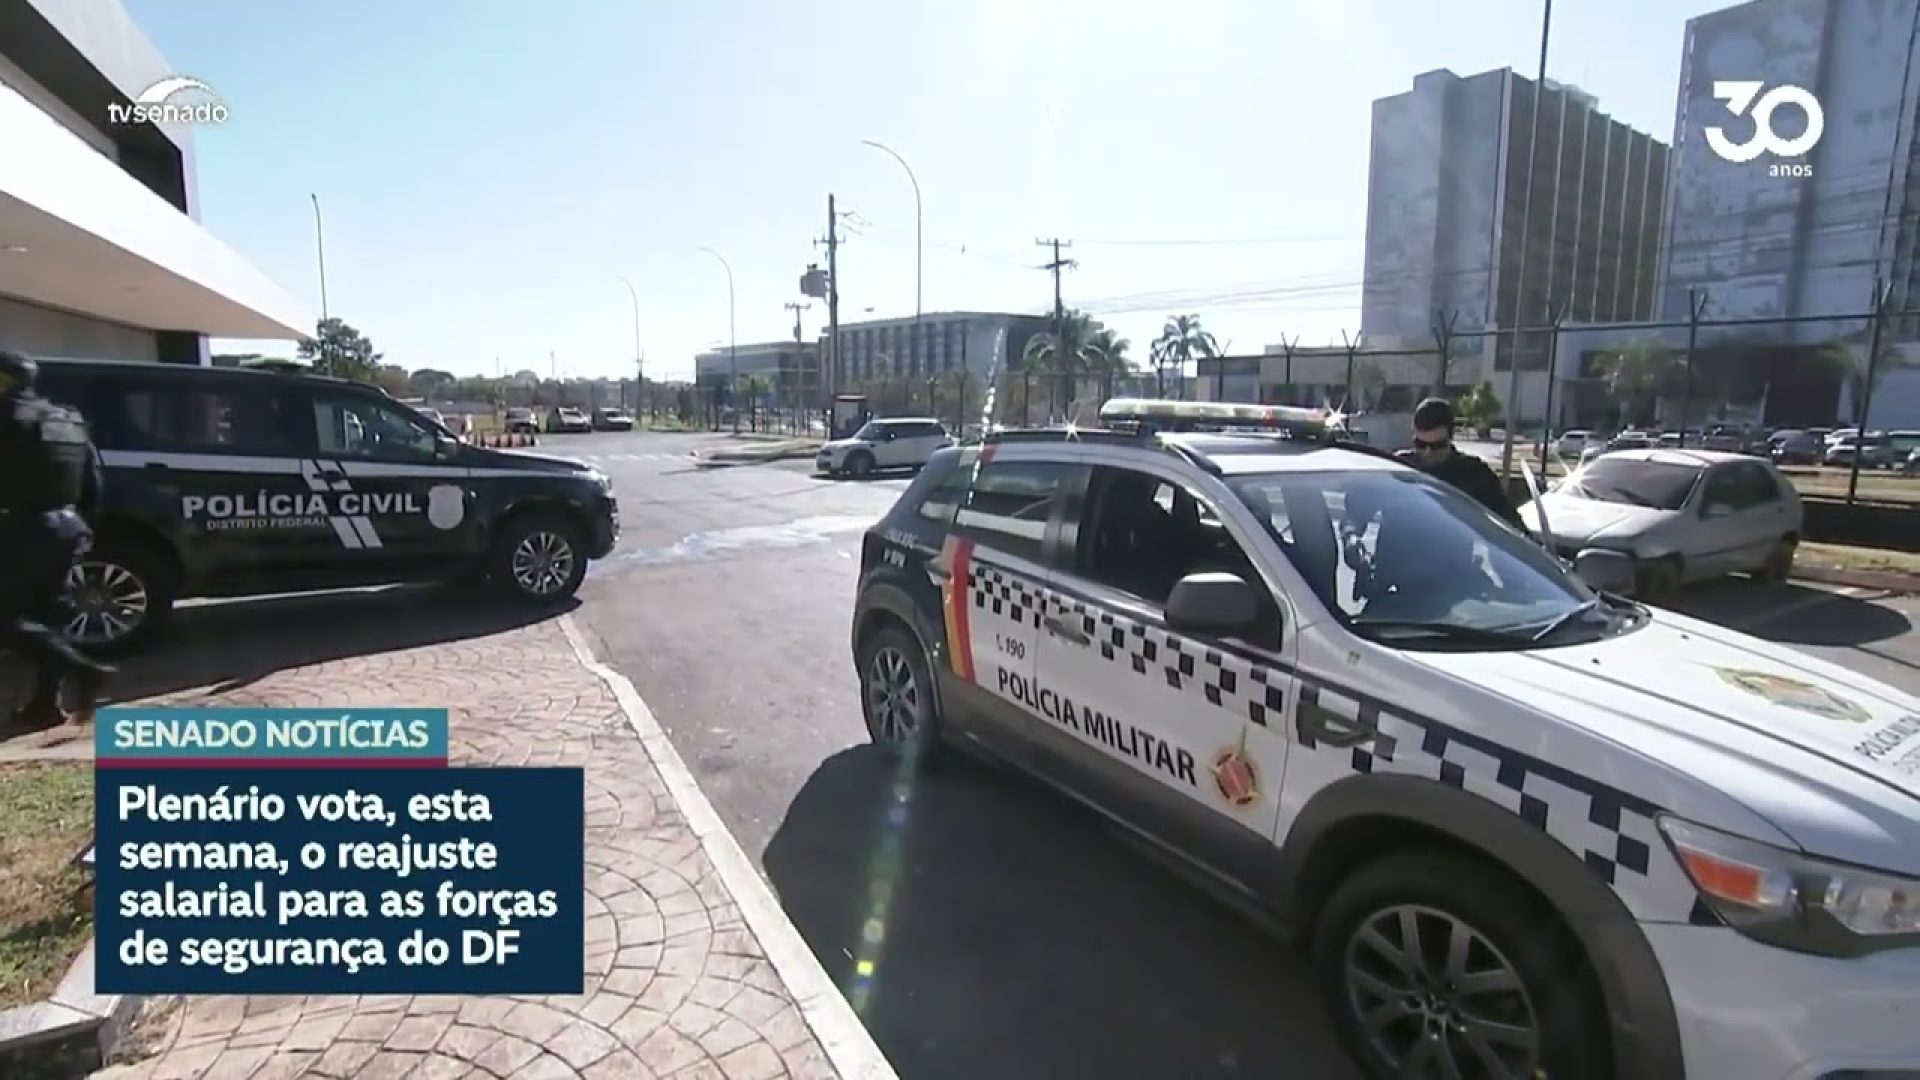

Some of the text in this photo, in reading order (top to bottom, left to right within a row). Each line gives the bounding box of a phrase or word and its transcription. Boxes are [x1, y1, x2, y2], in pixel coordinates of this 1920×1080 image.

[182, 489, 422, 519] POLÍCIA CIVIL
[206, 514, 328, 531] DISTRITO FEDERAL
[1005, 637, 1026, 660] 190
[998, 666, 1198, 787] POLÍCIA MILITAR
